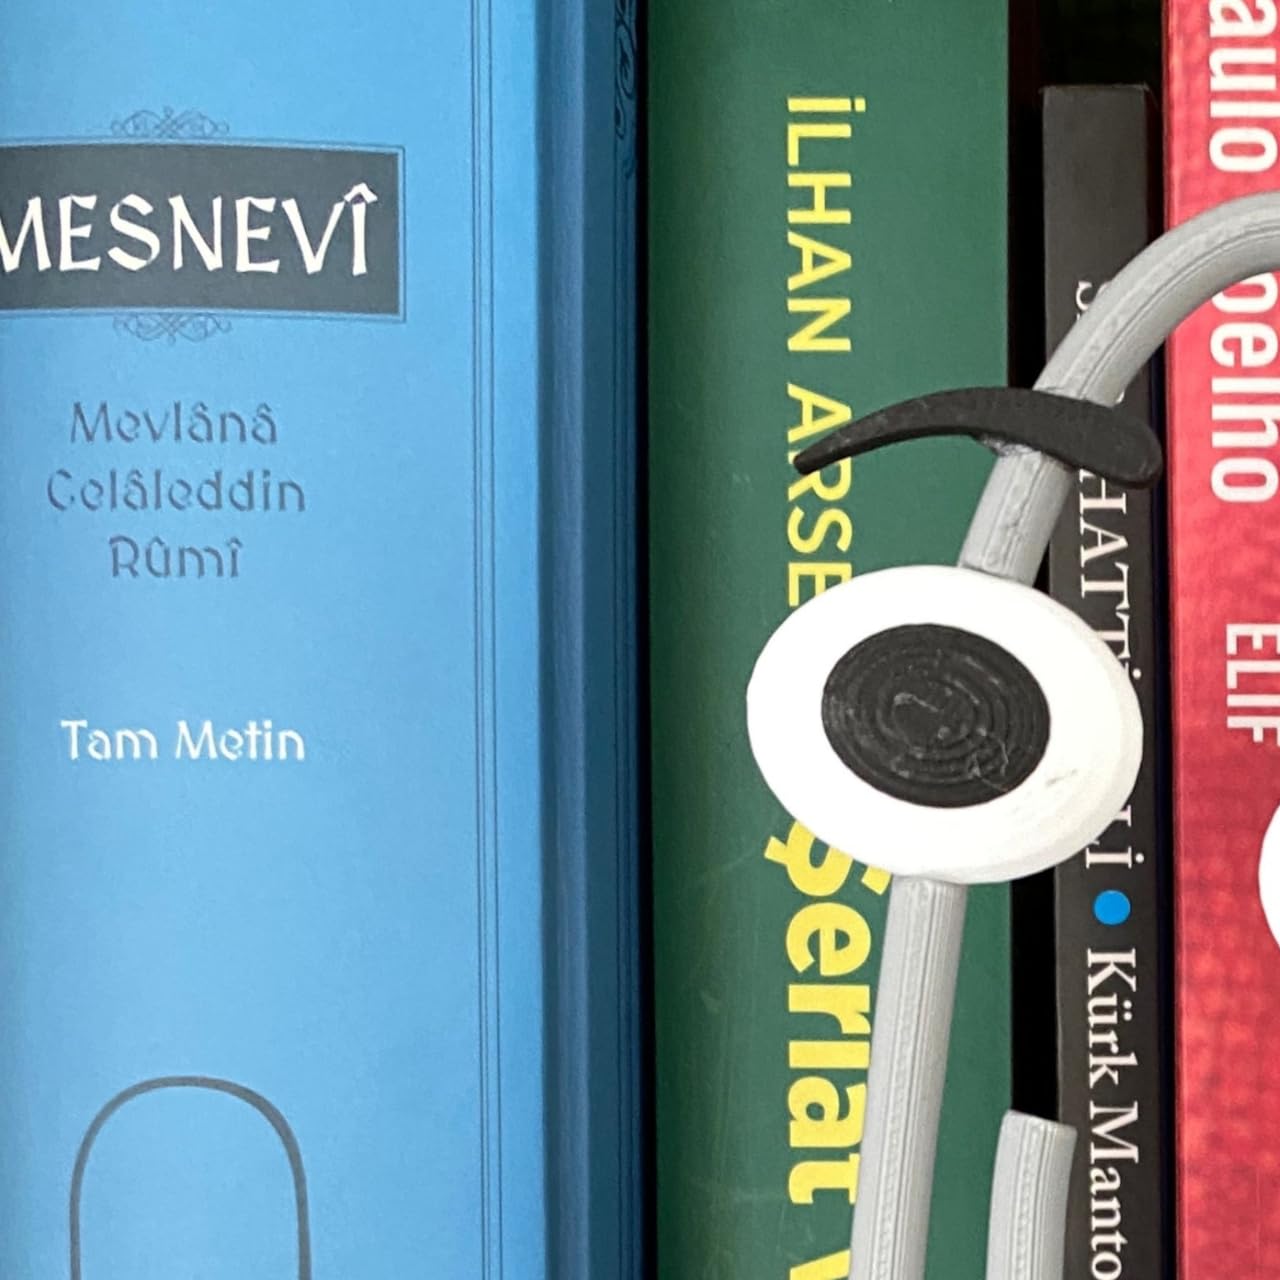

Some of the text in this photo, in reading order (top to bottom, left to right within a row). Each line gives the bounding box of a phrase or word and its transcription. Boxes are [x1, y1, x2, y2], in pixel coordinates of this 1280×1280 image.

[0, 182, 378, 276] MESNEVÎ
[787, 97, 866, 607] İLHAN ARSE
[109, 535, 243, 580] Rûmî
[61, 719, 306, 762] Tam Metin
[1087, 948, 1137, 1086] Kürk
